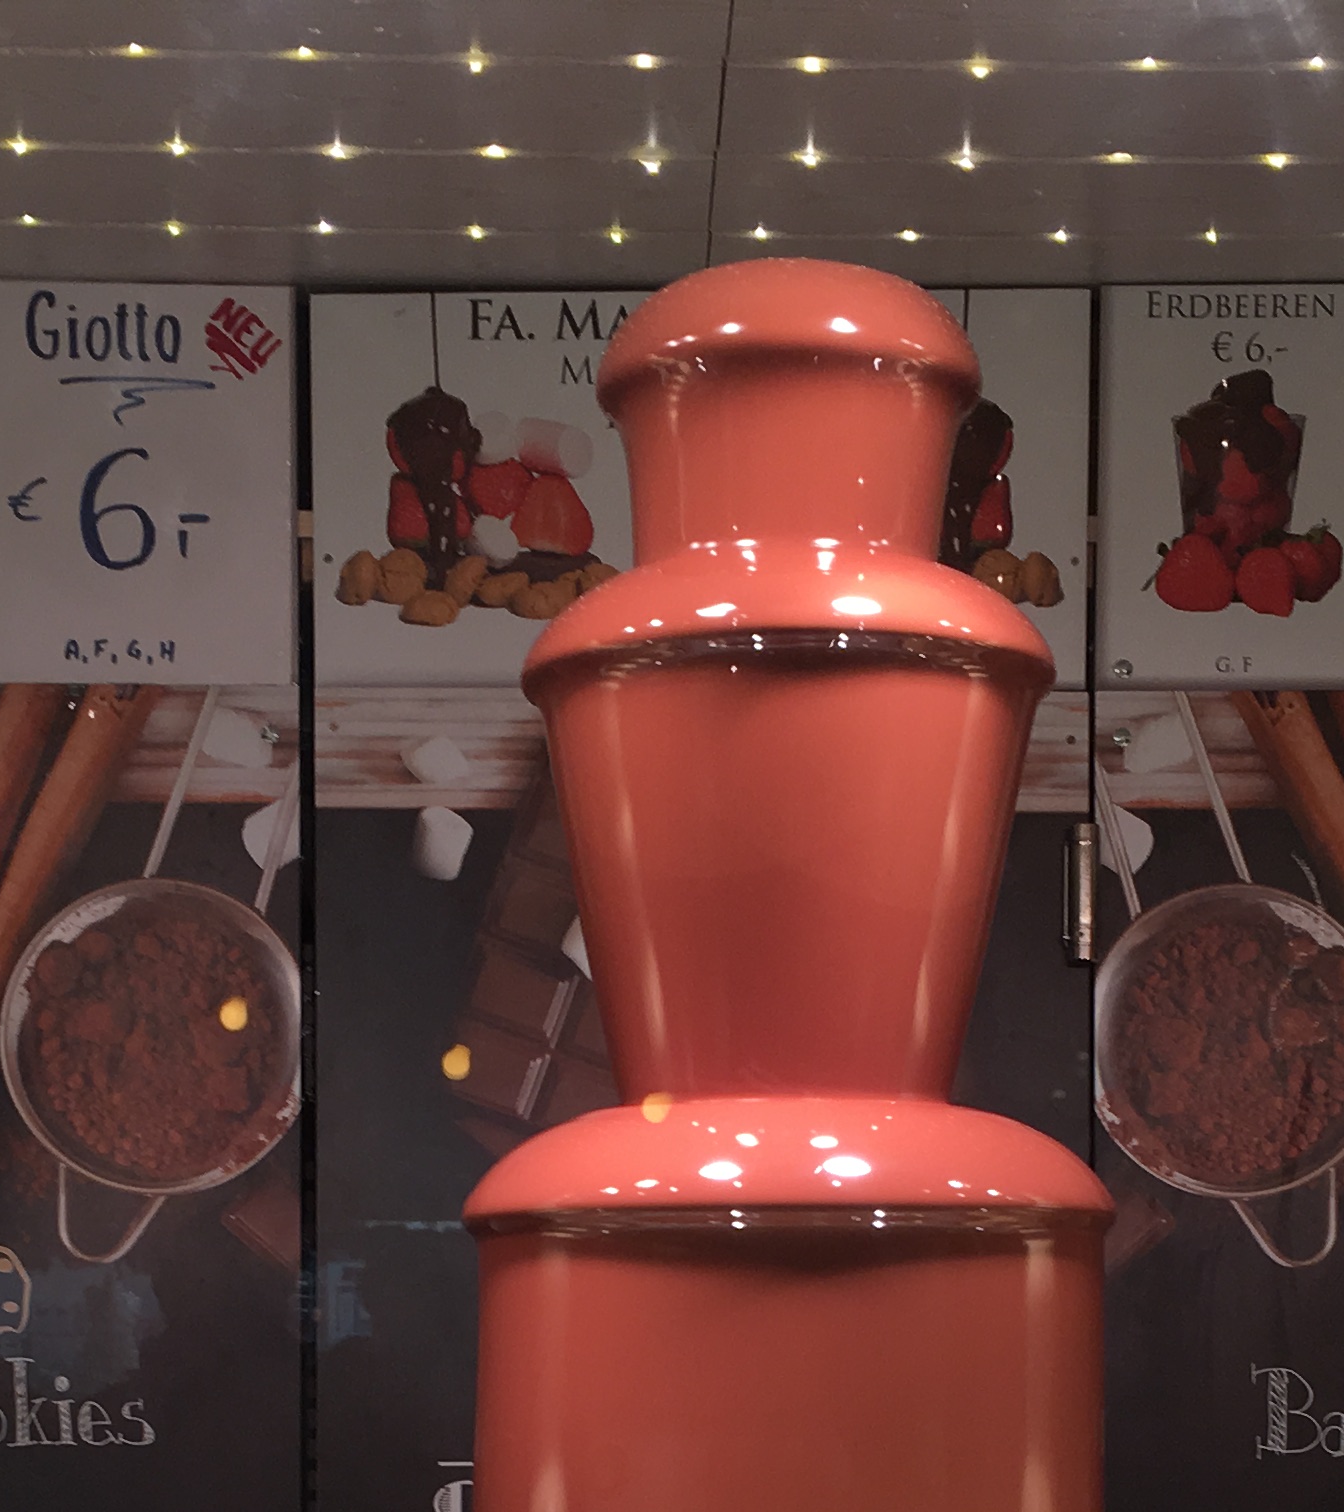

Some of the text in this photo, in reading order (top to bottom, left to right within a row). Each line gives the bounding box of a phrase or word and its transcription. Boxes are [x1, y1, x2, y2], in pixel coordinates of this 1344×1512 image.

[25, 289, 181, 363] Giotto
[468, 298, 535, 341] FA.
[1146, 289, 1336, 319] ERDBEEREN
[208, 297, 283, 369] NEU
[1211, 330, 1234, 363] €
[6, 476, 48, 522] €
